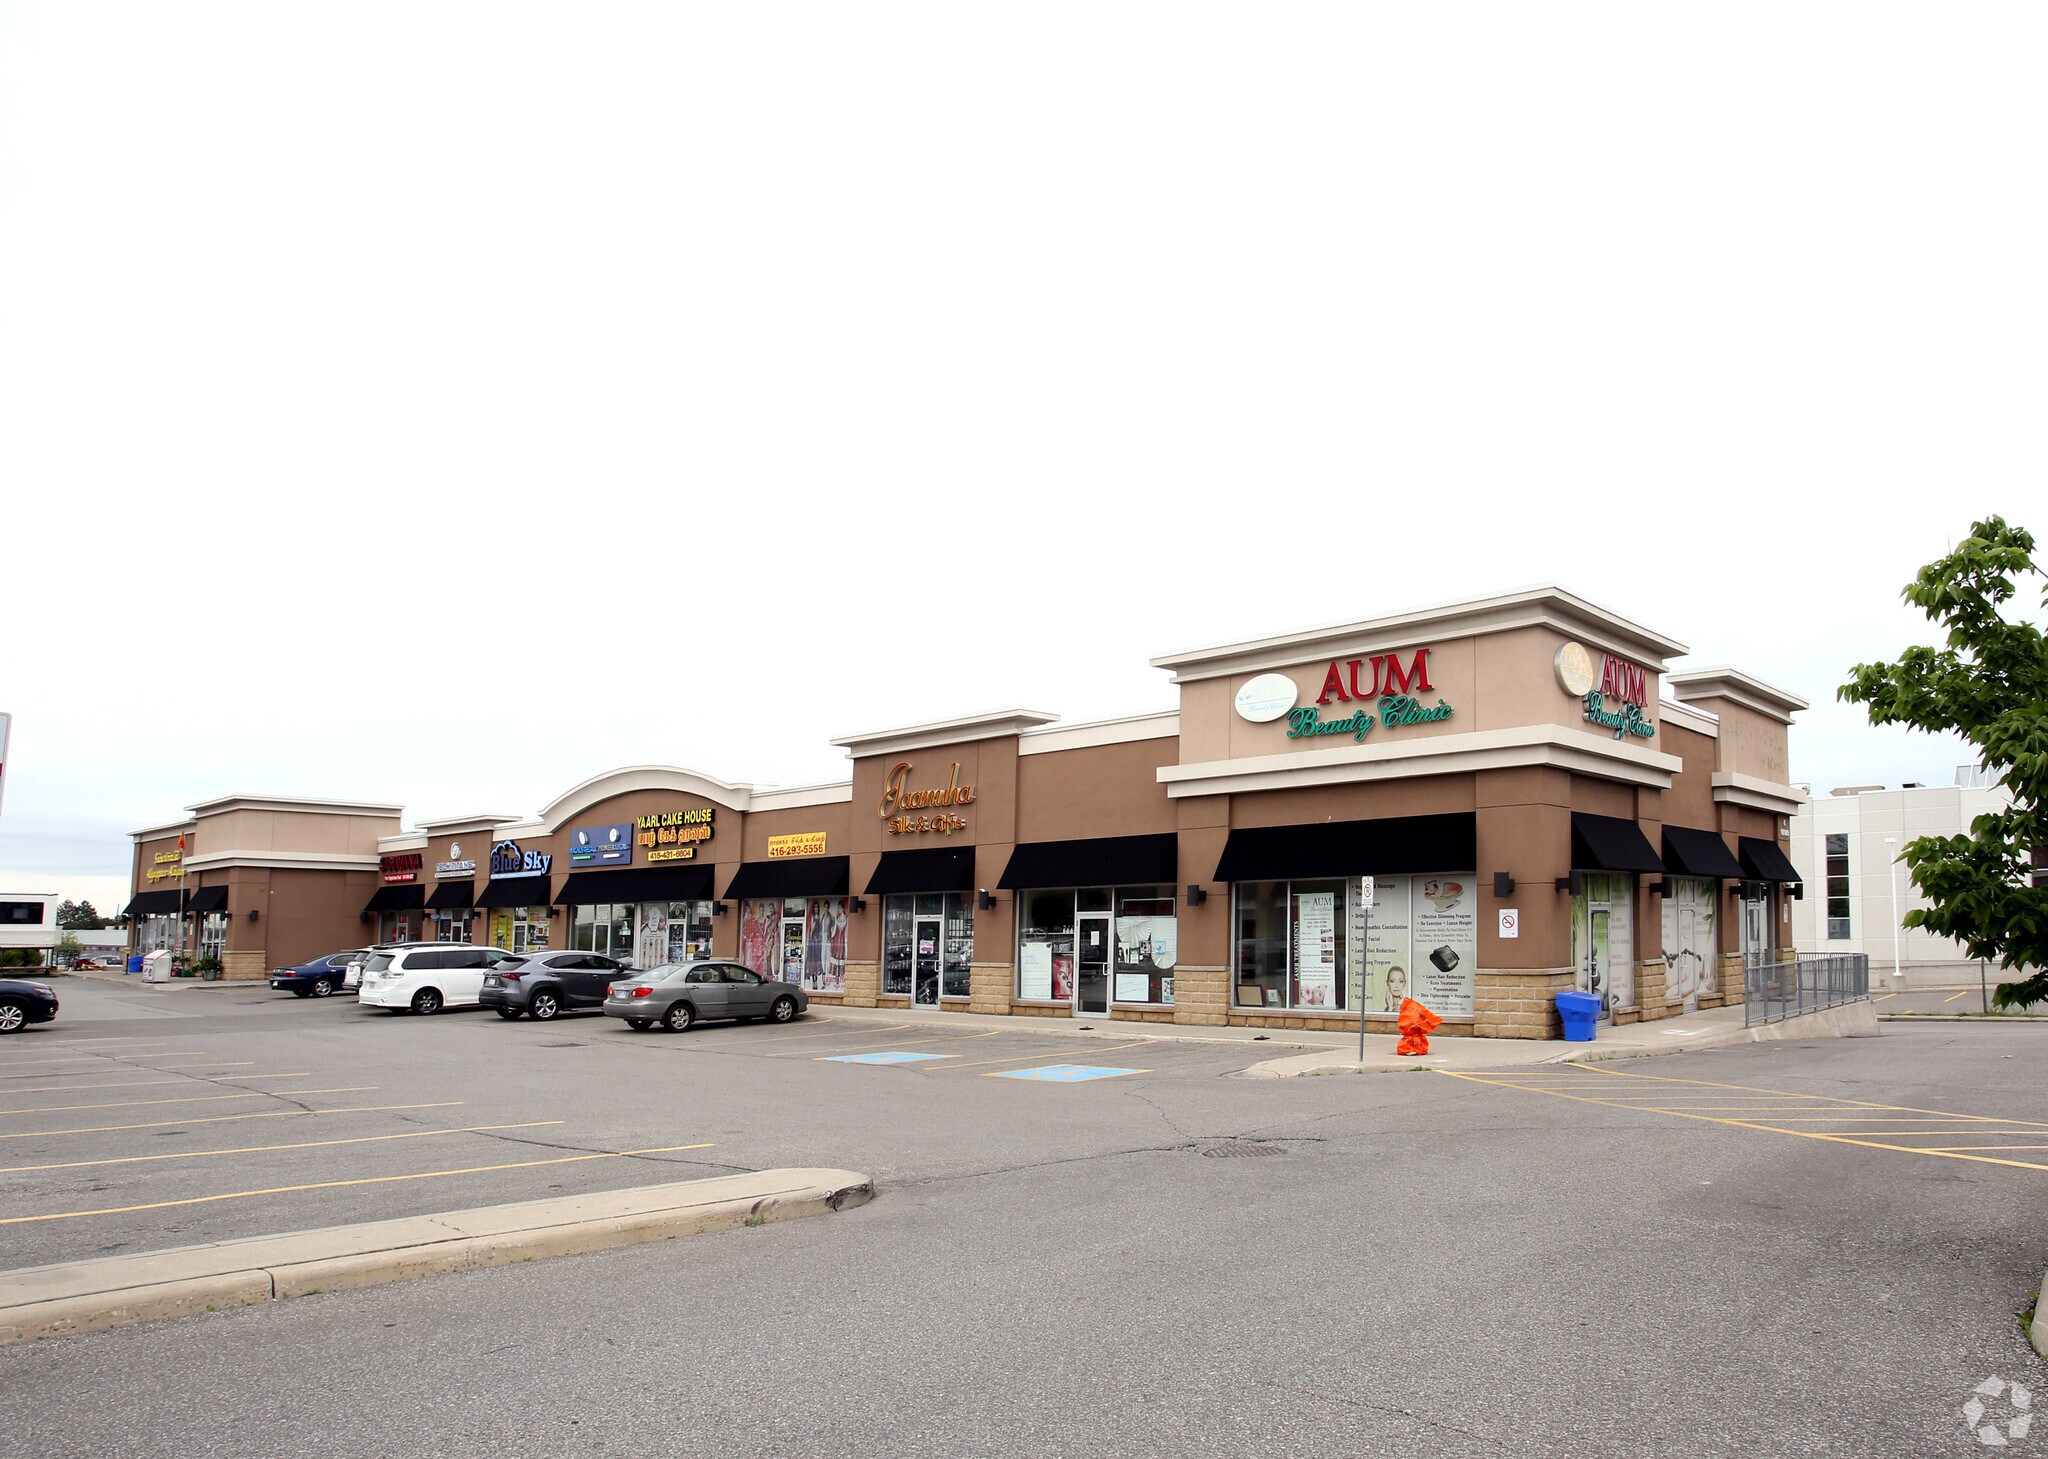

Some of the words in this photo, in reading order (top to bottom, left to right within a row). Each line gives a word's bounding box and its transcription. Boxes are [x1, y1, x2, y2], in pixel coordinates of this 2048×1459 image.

[1316, 649, 1435, 704] AUM
[1600, 653, 1648, 707] AUM
[1287, 707, 1376, 742] Beauty
[1377, 696, 1454, 728] Clinic
[1587, 690, 1627, 740] Beauty
[1626, 703, 1655, 738] Clinic
[878, 762, 977, 819] Jaanuha
[637, 815, 660, 829] YAARL
[661, 811, 683, 827] CAKE
[684, 808, 712, 824] HOUSE
[888, 815, 914, 834] Silk
[915, 816, 930, 832] &
[930, 812, 967, 836] Gifts
[492, 854, 520, 872] Blue
[523, 851, 550, 874] Sky
[770, 844, 824, 856] 416-293-5556
[1313, 897, 1332, 907] AUM
